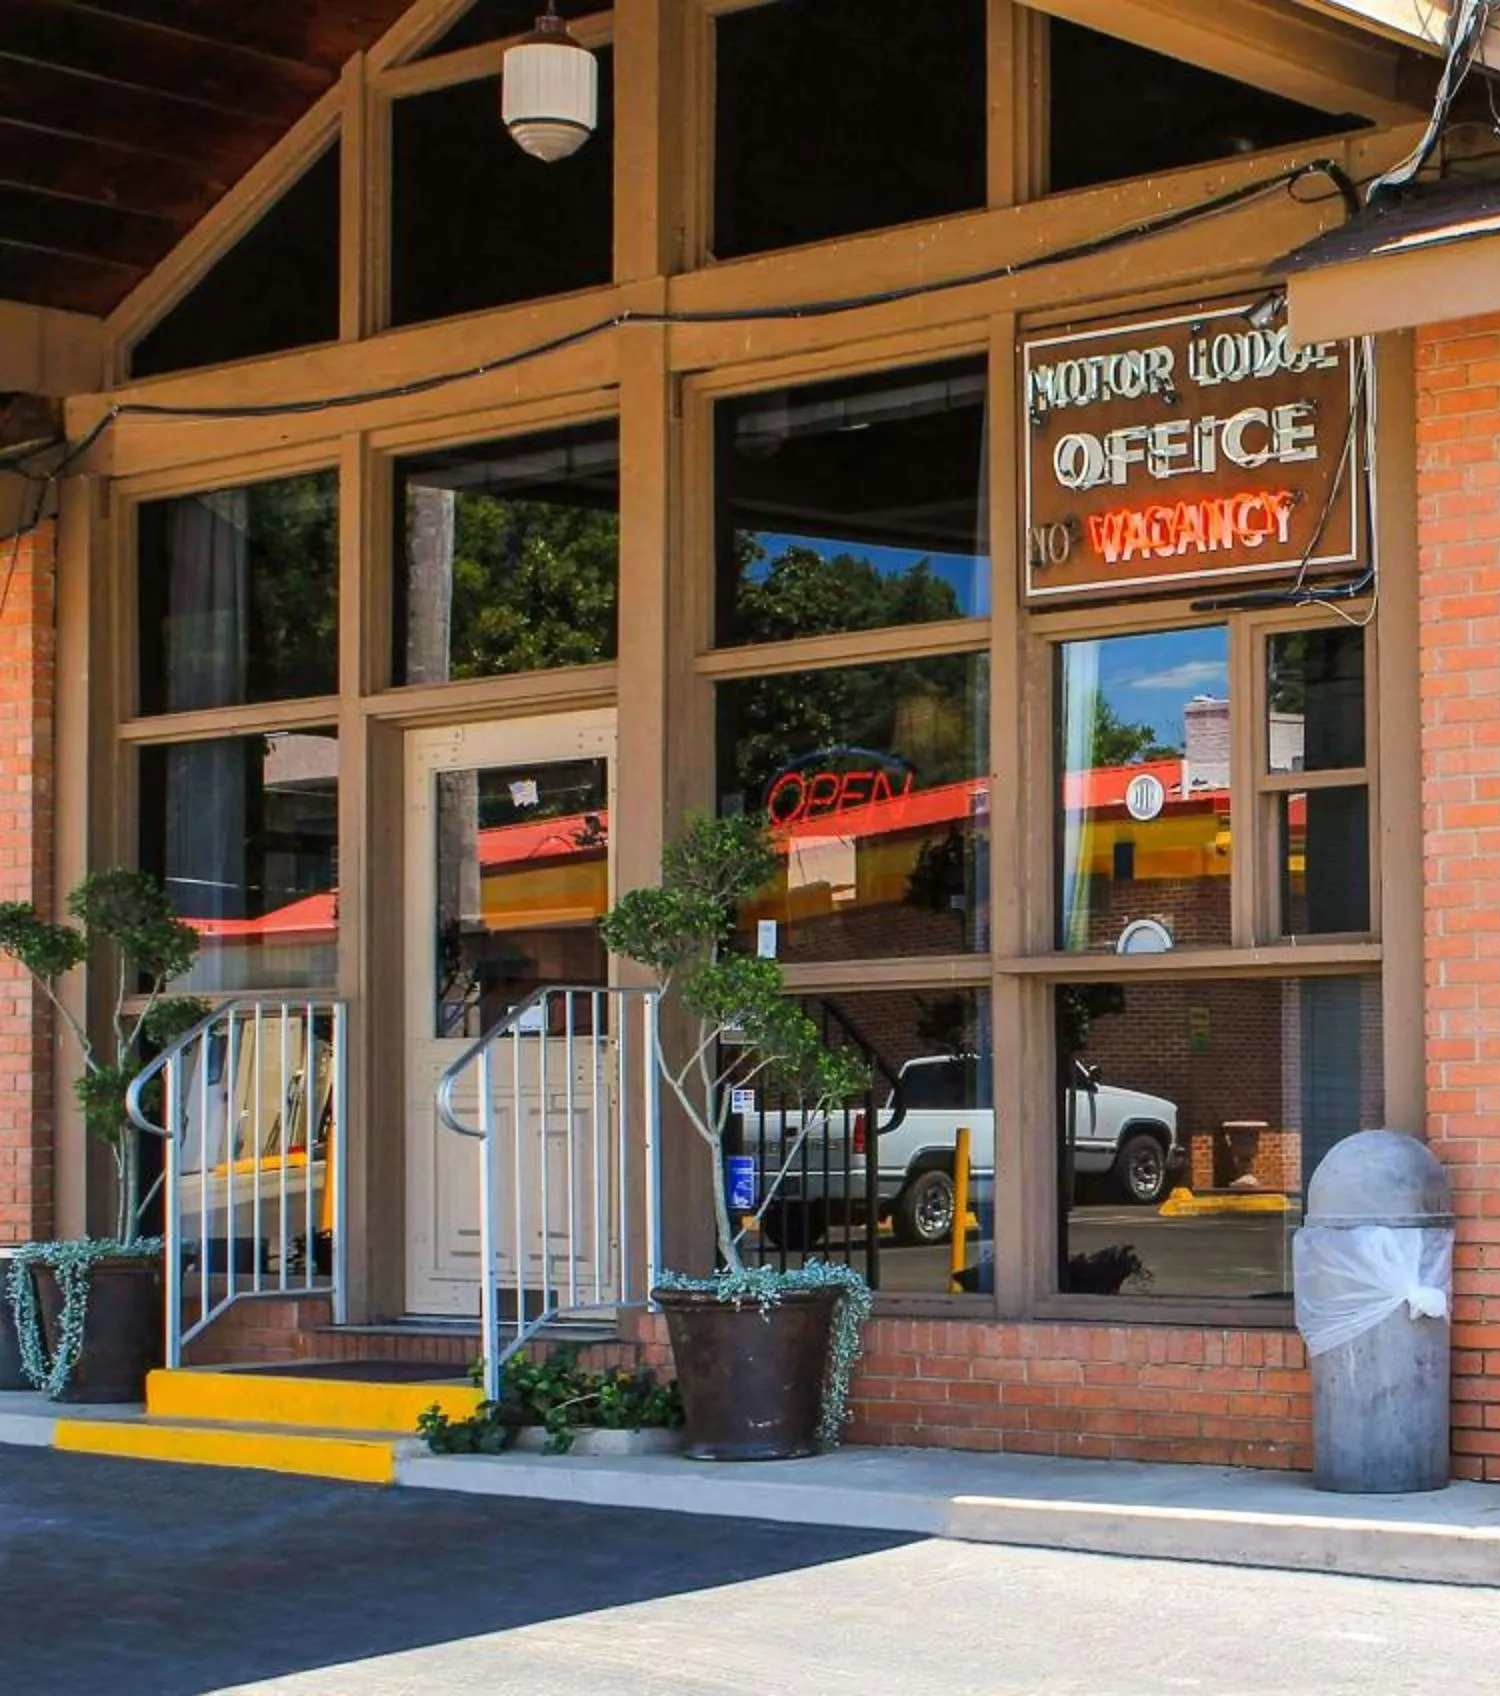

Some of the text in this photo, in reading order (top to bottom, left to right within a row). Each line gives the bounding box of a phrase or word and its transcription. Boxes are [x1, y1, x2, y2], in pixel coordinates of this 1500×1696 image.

[1028, 344, 1176, 411] MOTOR
[1053, 401, 1319, 490] OFFICE
[1029, 490, 1297, 568] NO VACANCY
[768, 770, 914, 826] OPEN
